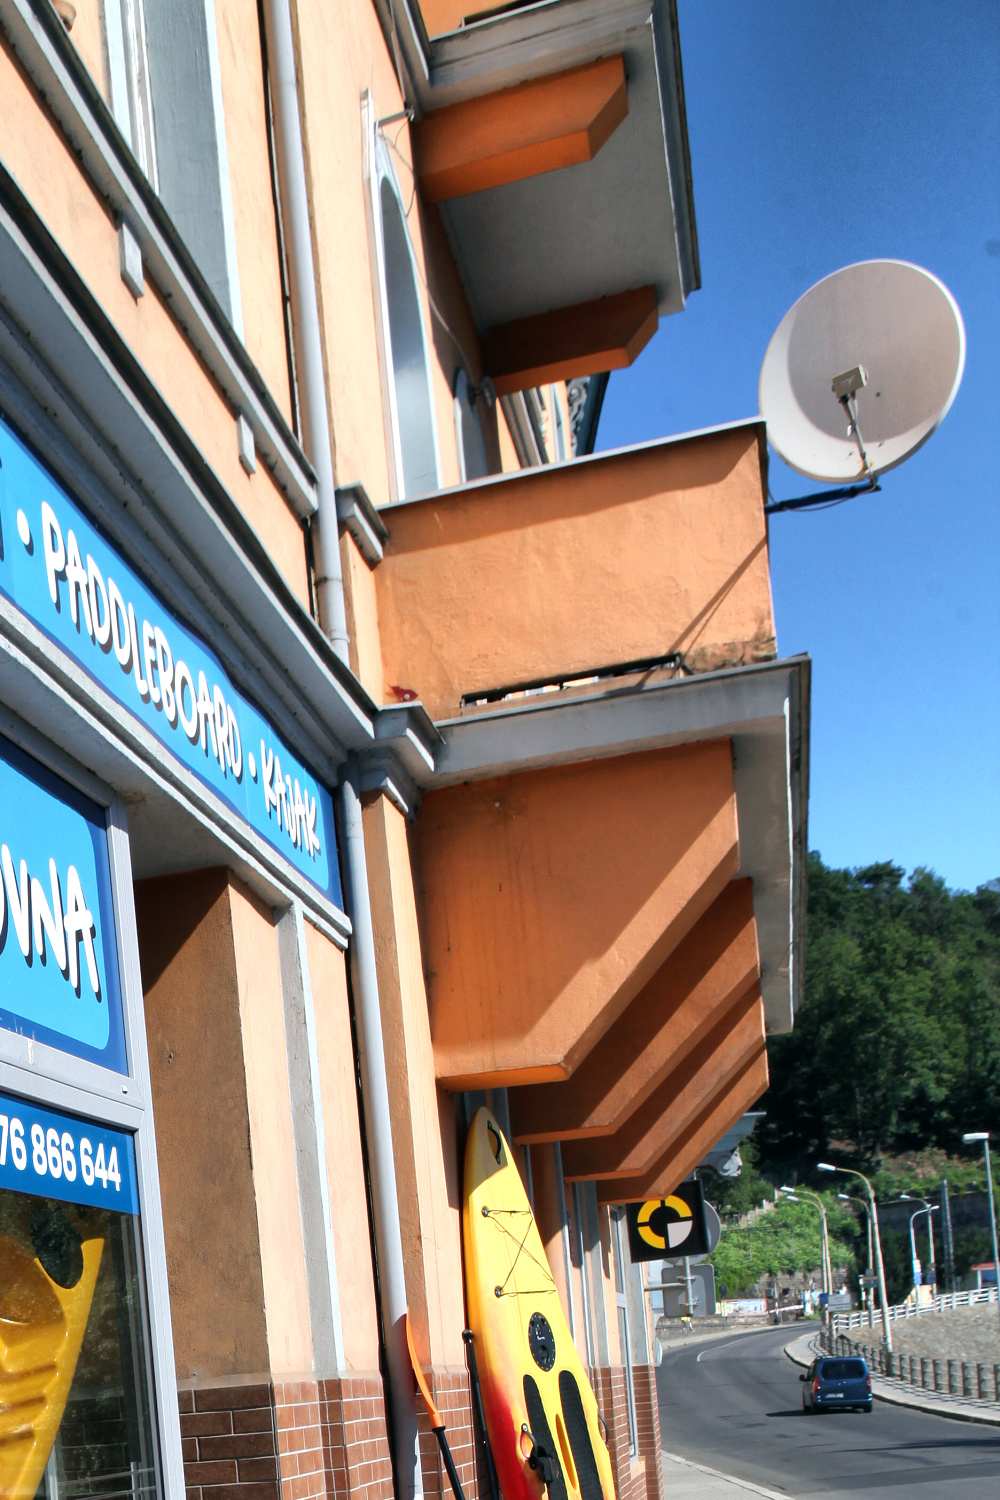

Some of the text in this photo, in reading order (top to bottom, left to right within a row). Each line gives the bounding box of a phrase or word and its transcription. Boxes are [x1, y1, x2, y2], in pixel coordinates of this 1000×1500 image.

[41, 500, 243, 779] PADDLEBOARD
[260, 738, 321, 860] KAJAK
[30, 1122, 78, 1183] 866
[79, 1136, 122, 1192] 644
